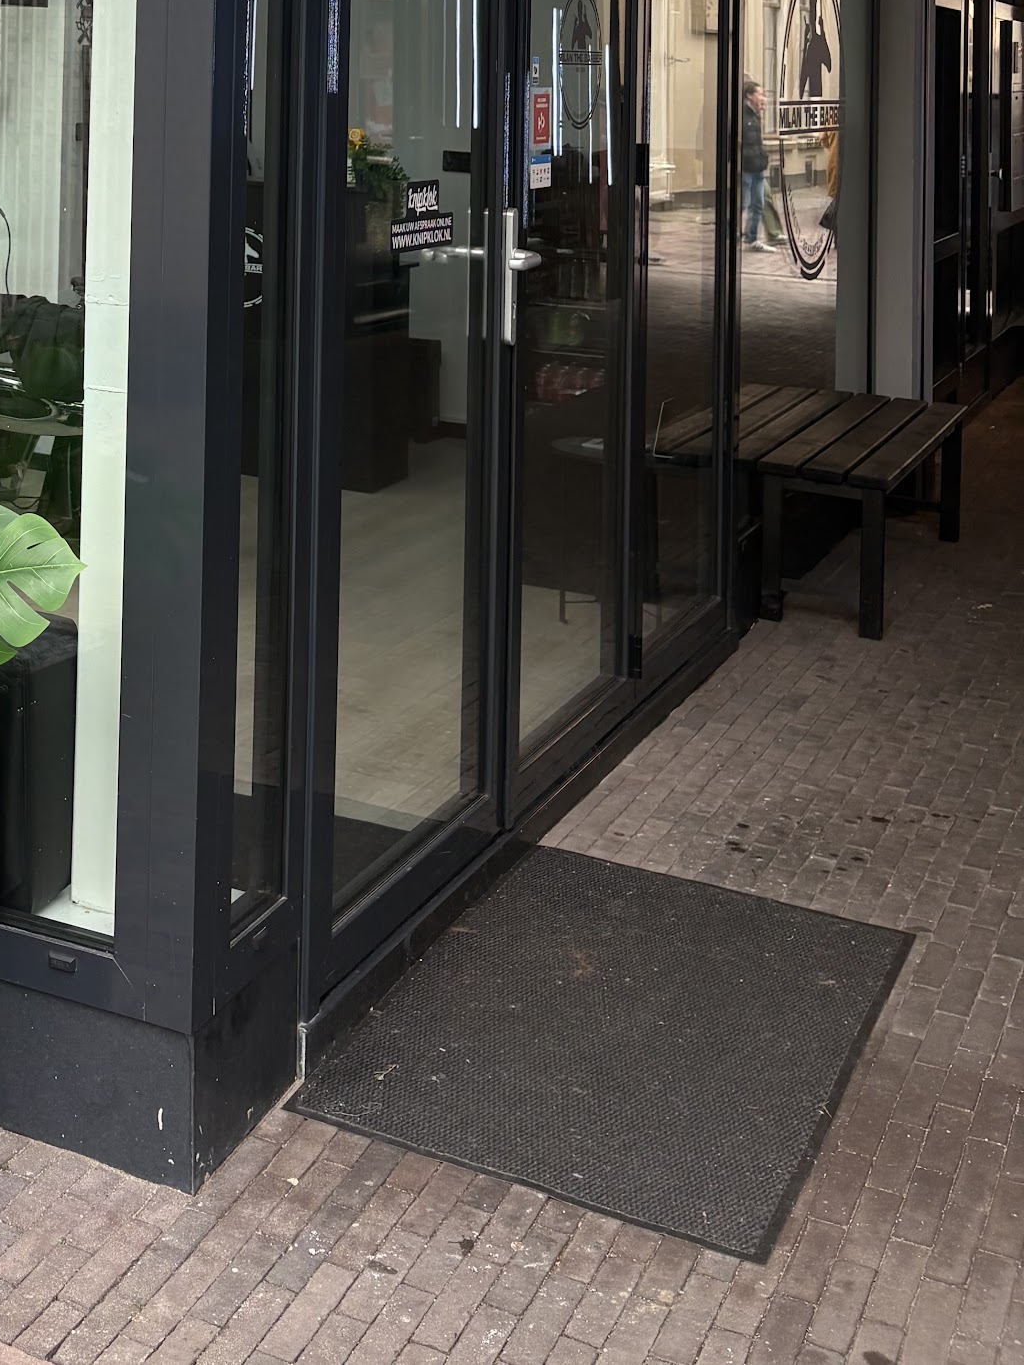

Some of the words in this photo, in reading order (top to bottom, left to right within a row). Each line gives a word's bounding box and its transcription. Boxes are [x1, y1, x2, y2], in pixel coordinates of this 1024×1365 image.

[779, 106, 802, 129] MILAN
[804, 106, 818, 127] THE
[819, 106, 839, 126] BARB
[392, 222, 406, 234] MAAK
[414, 218, 437, 231] AFSPRAAK
[437, 217, 452, 227] ONLINE
[392, 228, 452, 249] WWW.KNIPKLOK.NL
